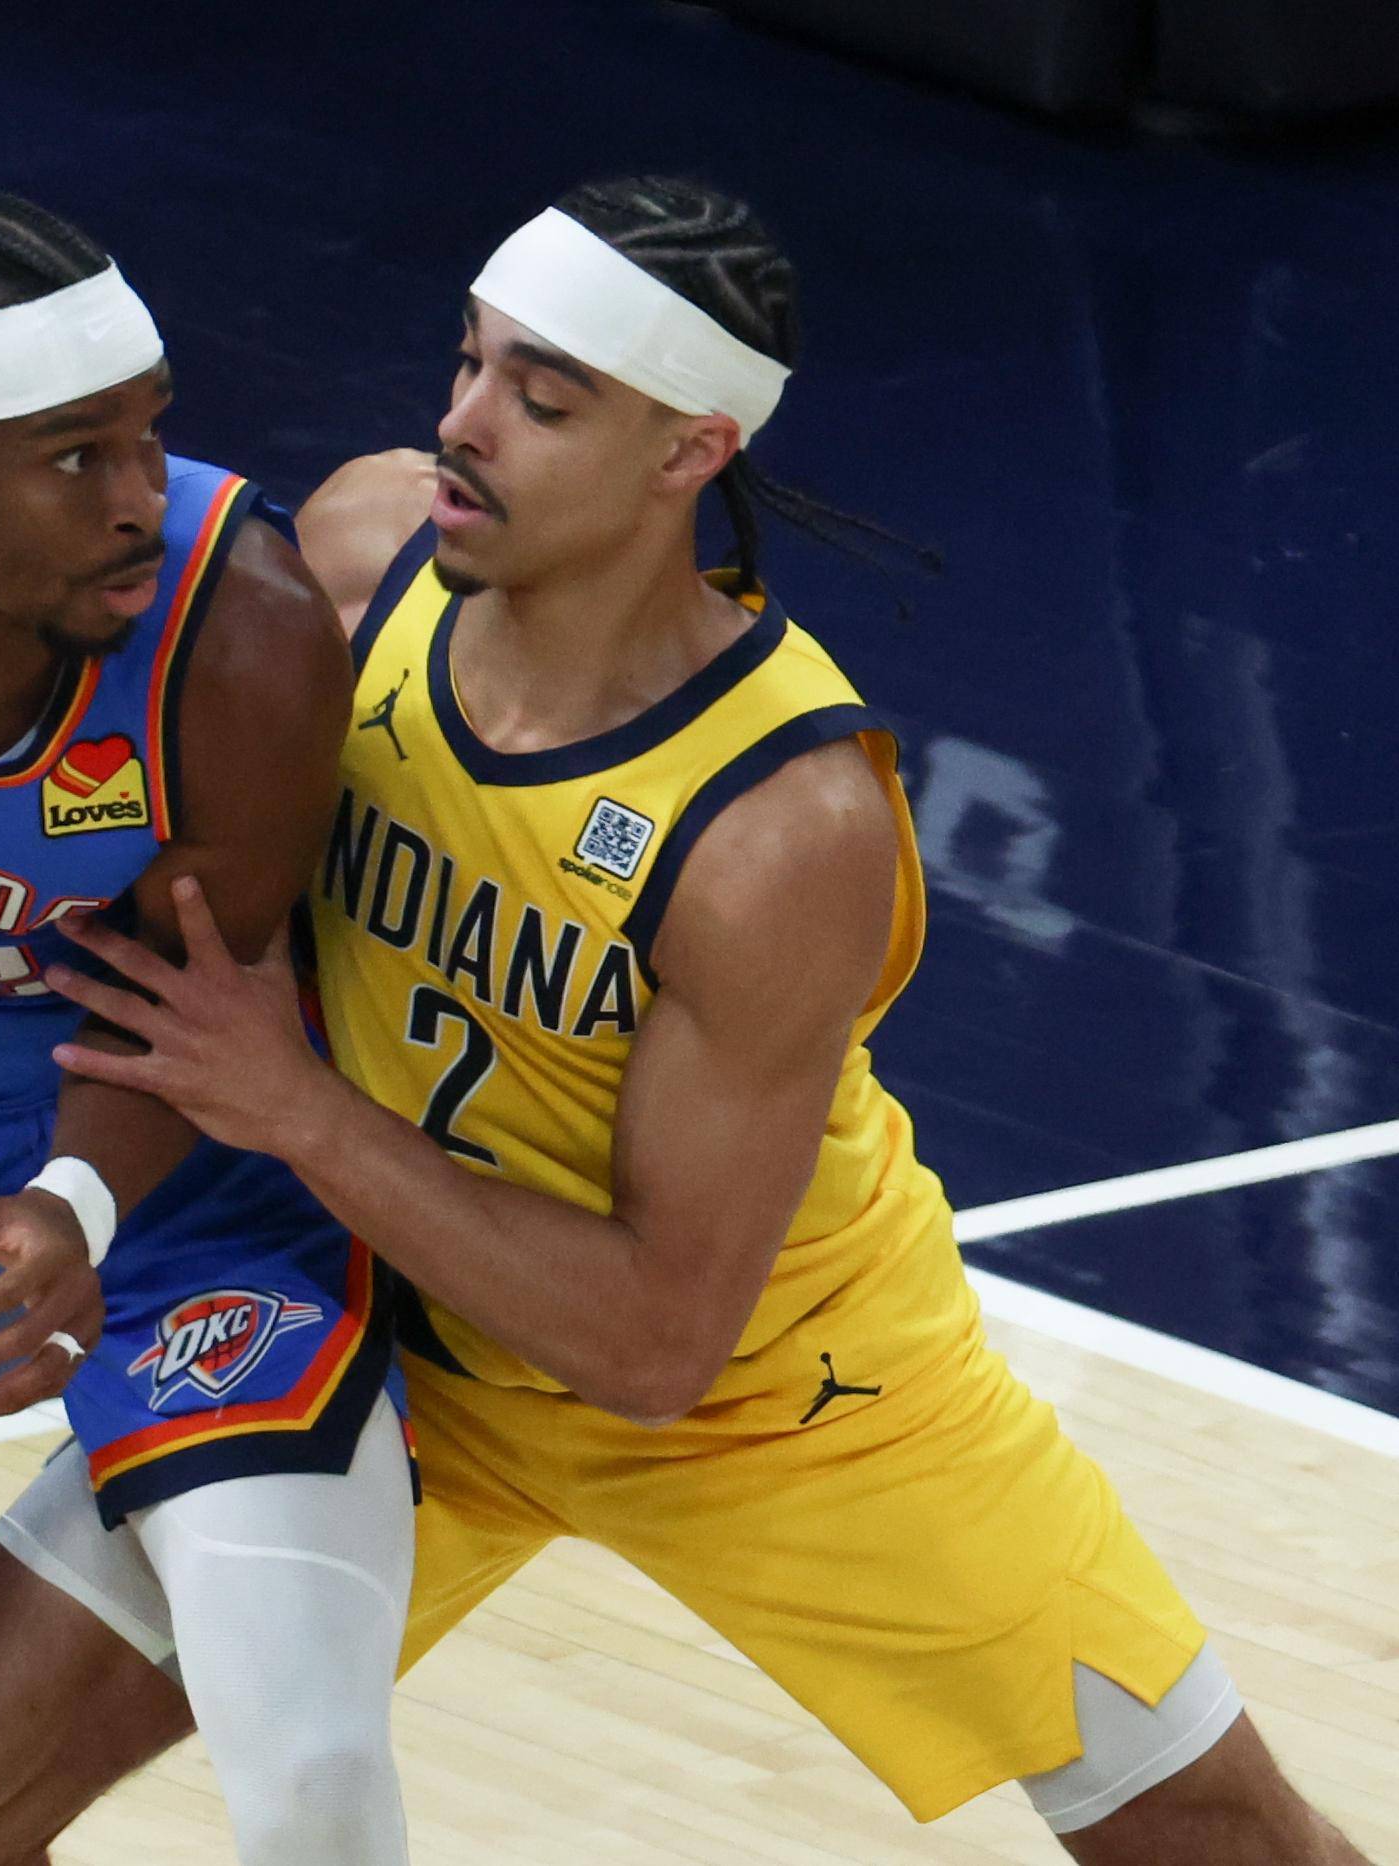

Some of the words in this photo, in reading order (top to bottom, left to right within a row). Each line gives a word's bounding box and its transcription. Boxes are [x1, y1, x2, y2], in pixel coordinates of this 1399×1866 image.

[323, 786, 637, 1038] NDIANA
[405, 983, 502, 1170] 2
[155, 1303, 253, 1387] OKC
